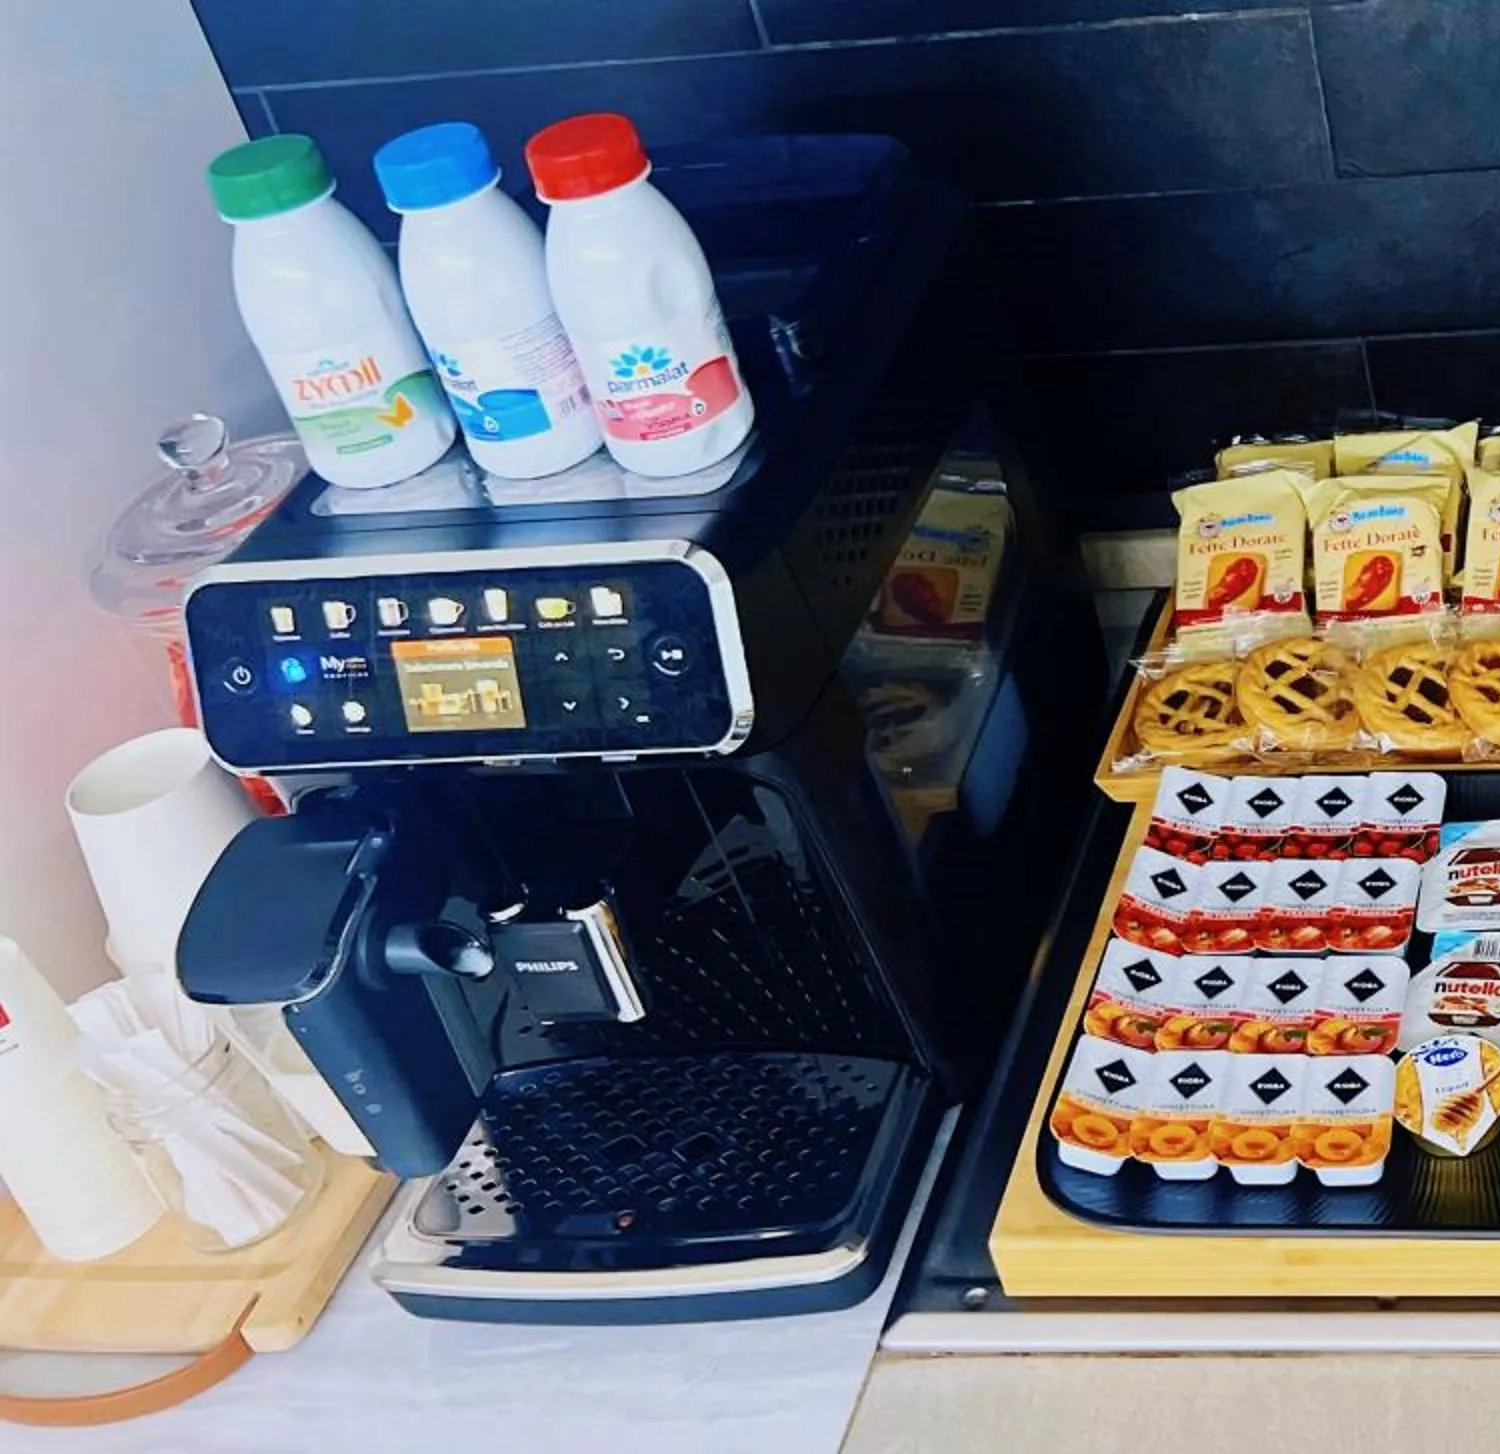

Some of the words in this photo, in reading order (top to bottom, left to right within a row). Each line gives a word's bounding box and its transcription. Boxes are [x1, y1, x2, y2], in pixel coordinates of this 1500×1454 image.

[607, 361, 689, 393] parmalat
[1188, 540, 1228, 555] Fette
[1232, 534, 1287, 548] Dorate
[1323, 538, 1361, 553] Fette
[1366, 527, 1420, 546] Dorate
[514, 960, 579, 972] PHILIPS
[1428, 1050, 1466, 1066] Hero
